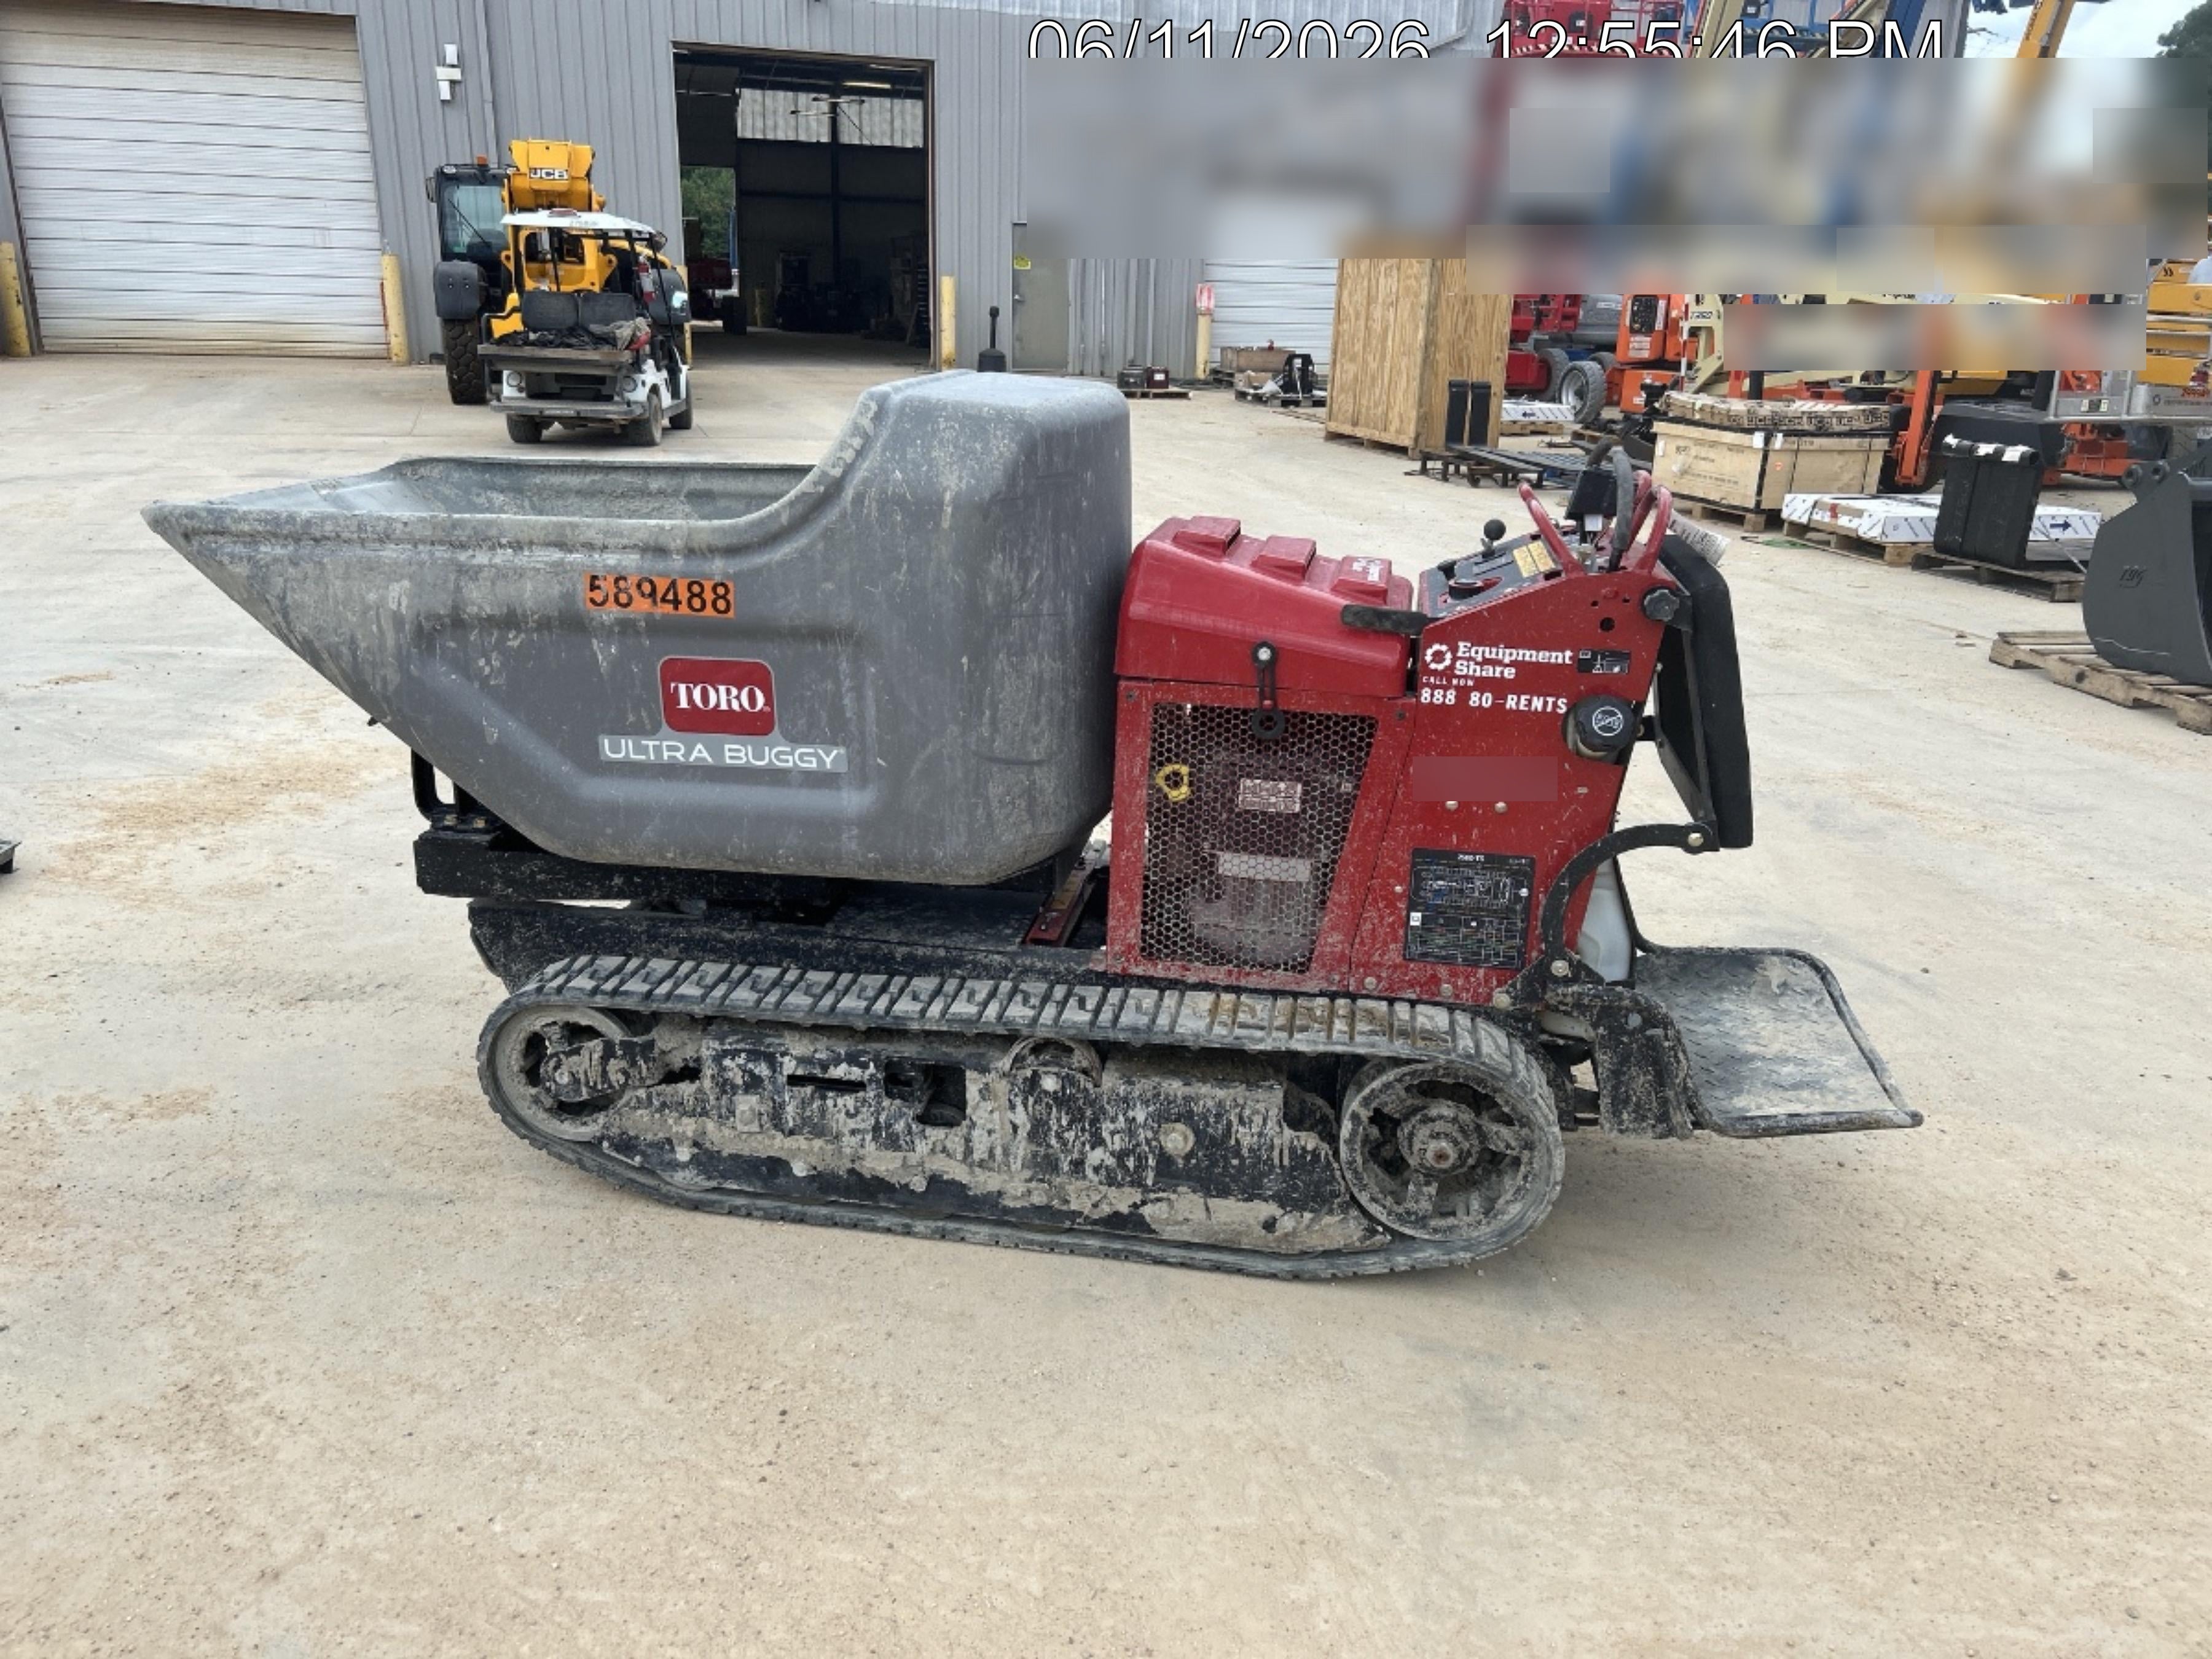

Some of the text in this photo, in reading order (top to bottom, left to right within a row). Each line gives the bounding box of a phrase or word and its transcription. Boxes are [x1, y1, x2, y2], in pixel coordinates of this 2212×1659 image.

[530, 168, 568, 179] JCB
[589, 574, 732, 614] 589488
[1456, 641, 1573, 664] Equipment
[1454, 660, 1516, 679] Share
[671, 682, 766, 712] TORO
[1421, 688, 1457, 705] 888
[604, 739, 839, 769] ULTRA BUGGY
